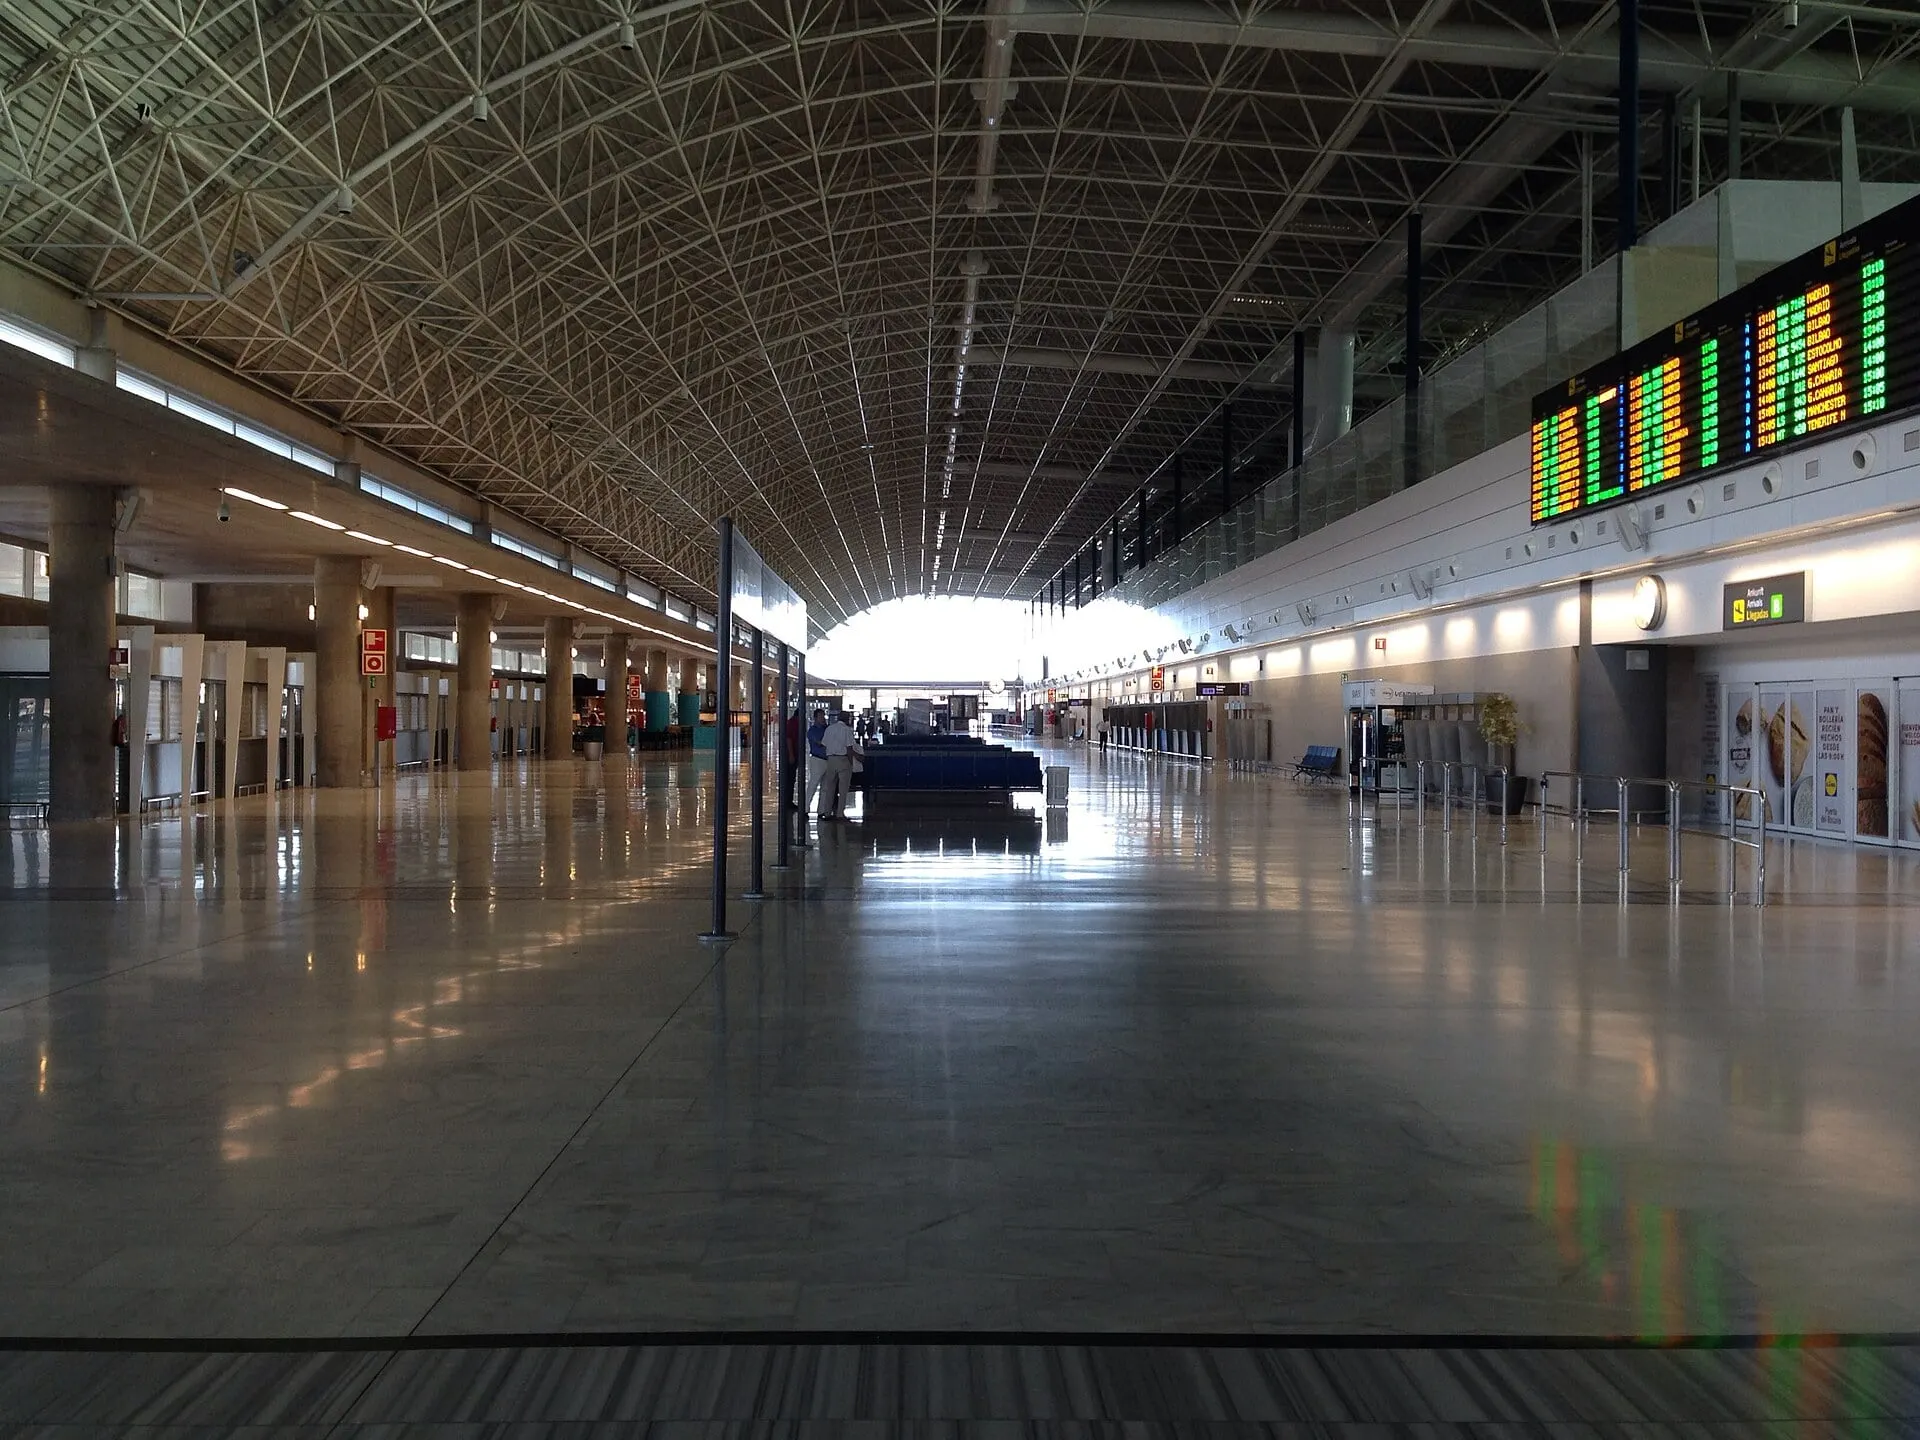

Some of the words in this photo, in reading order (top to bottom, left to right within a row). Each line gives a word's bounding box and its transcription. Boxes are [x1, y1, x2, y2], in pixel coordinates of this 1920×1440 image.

[1759, 310, 1775, 326] 13:10
[1807, 285, 1829, 304] MADRID
[1863, 259, 1884, 278] 13:10
[1759, 324, 1775, 340] 13:10
[1807, 299, 1830, 318] MADRID
[1863, 275, 1884, 293] 13:10
[1807, 313, 1830, 332] BILBAO
[1807, 328, 1830, 346] BILBAO
[1759, 364, 1775, 380] 13:45
[1808, 338, 1842, 361] ESTOCOLMO
[1808, 354, 1838, 375] SANTIAGO
[1808, 367, 1842, 389] G.CANARIA
[1808, 382, 1842, 403] G.CANARIA
[1808, 395, 1846, 417] MANCHESTER
[1758, 433, 1775, 447] 15:10
[1808, 412, 1838, 431] TENERIFE
[1864, 397, 1885, 413] 15:10
[1747, 599, 1763, 608] Arrivals
[1773, 599, 1780, 613] B
[1747, 610, 1769, 622] Llegadas
[1820, 733, 1842, 742] HECHOS
[1822, 743, 1840, 751] DESDE
[1818, 752, 1828, 760] LAS
